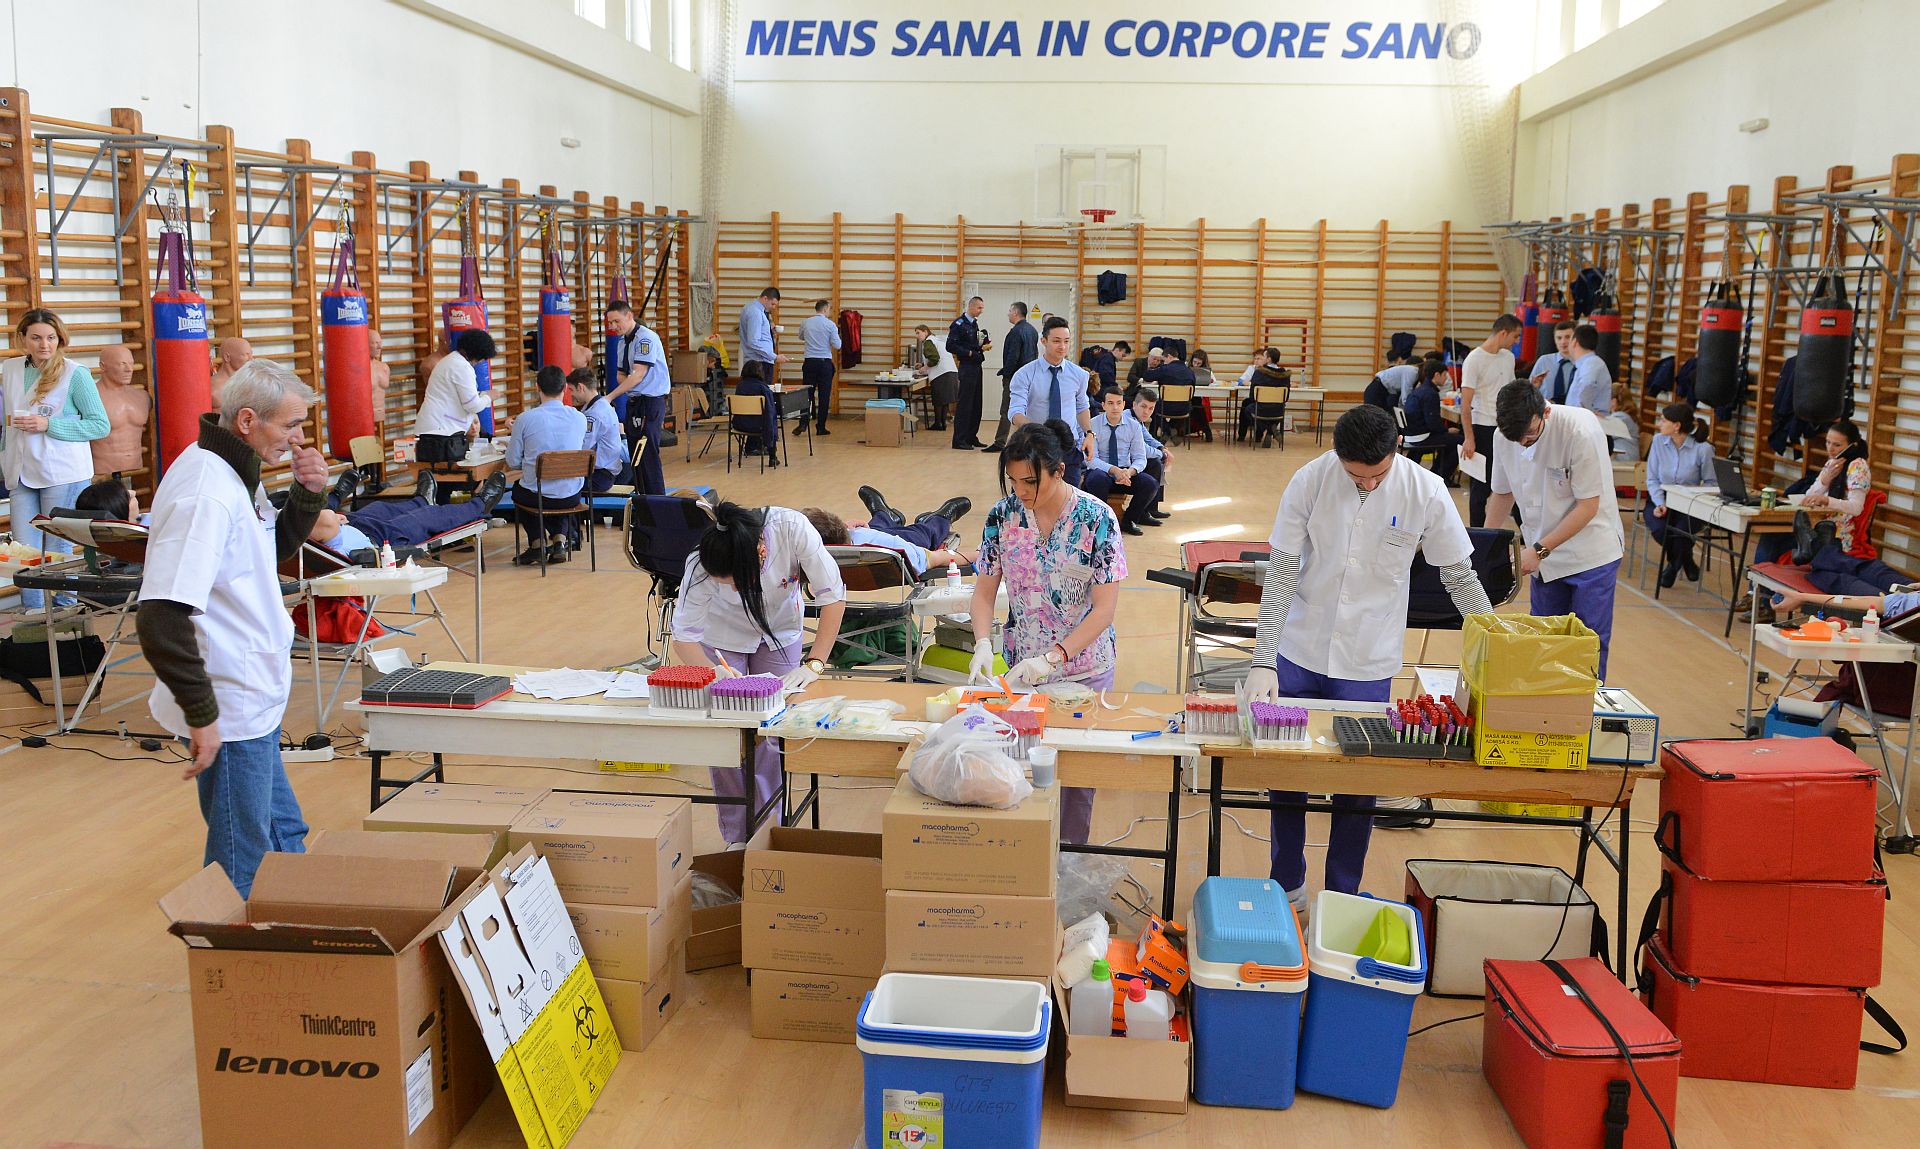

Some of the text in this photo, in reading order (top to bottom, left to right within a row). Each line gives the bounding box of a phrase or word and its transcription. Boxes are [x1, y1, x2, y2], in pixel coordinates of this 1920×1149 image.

[746, 20, 1482, 60] MENS SANA IN CORPORE SANO
[922, 823, 970, 833] macopharma
[544, 841, 586, 851] macopharma
[776, 911, 819, 921] macopharma
[926, 906, 976, 916] macopharma
[312, 939, 378, 949] lenovo
[787, 981, 831, 990] macopharma
[300, 1013, 376, 1037] ThinkCentre
[440, 985, 449, 1092] lenovo
[215, 1047, 380, 1080] lenovo
